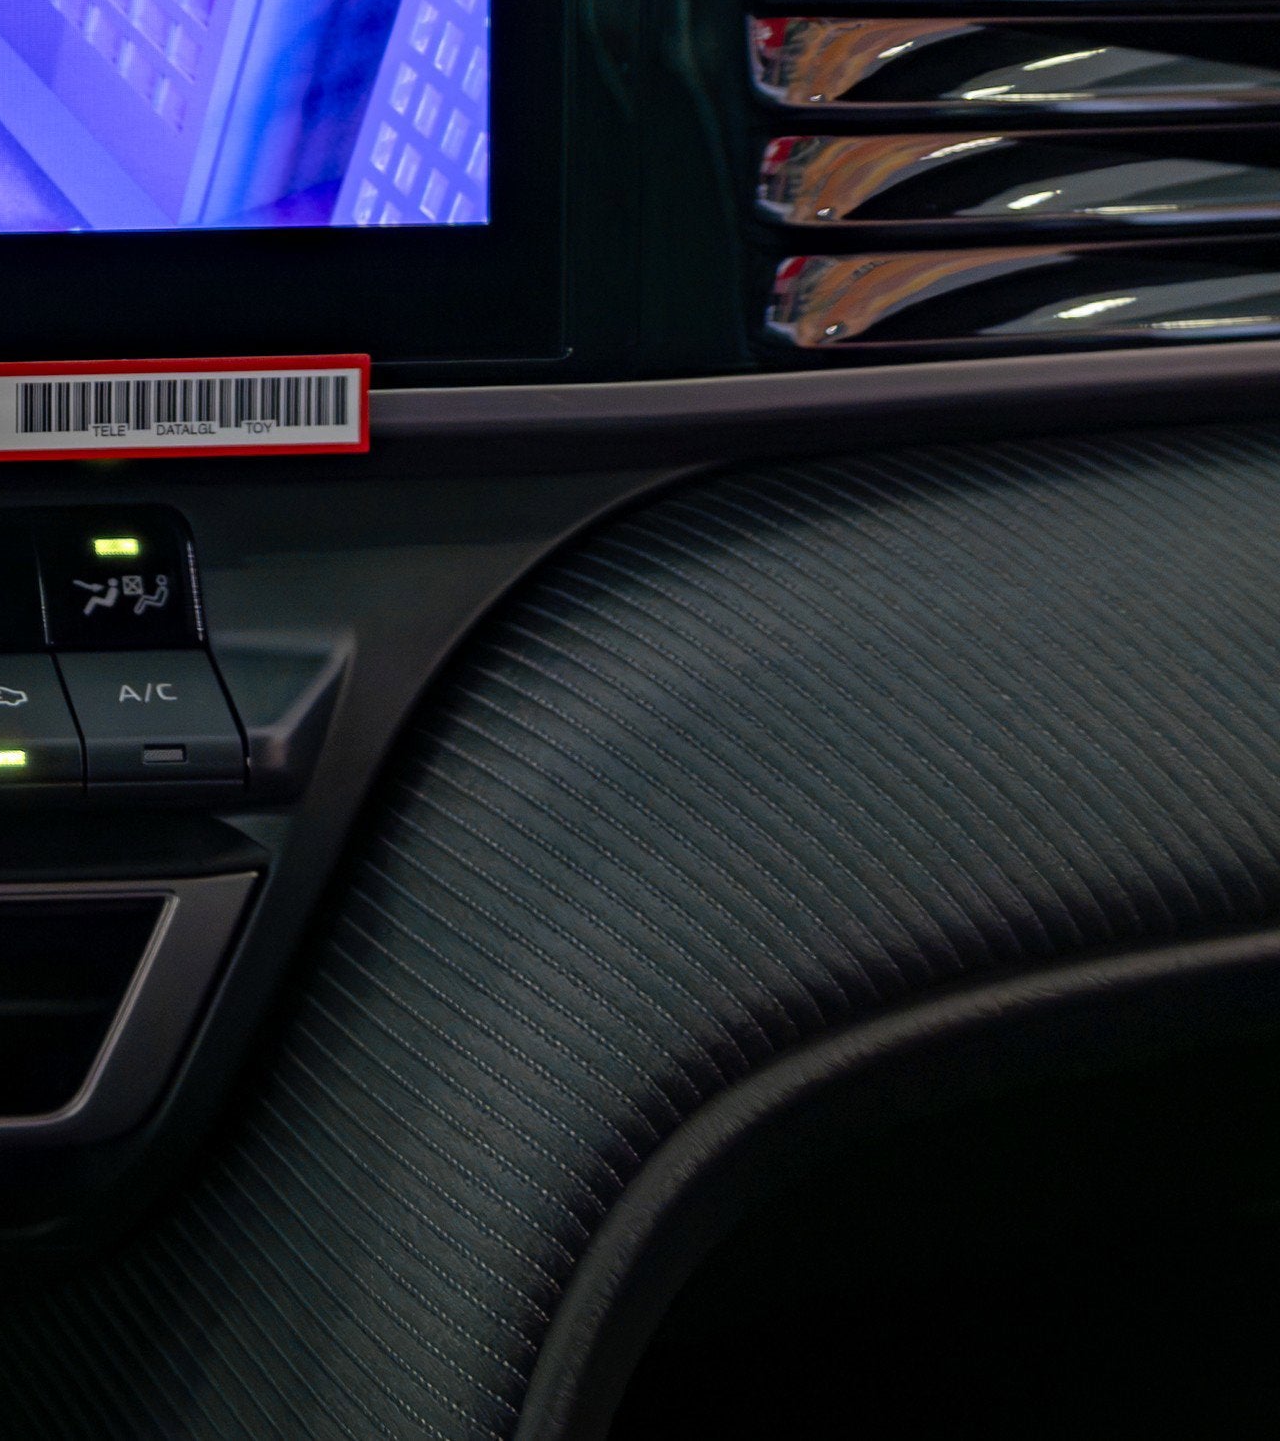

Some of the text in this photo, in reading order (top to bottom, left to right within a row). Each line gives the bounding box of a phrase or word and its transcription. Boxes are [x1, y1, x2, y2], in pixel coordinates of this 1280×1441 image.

[92, 425, 126, 437] TELE
[245, 421, 273, 434] TOY
[118, 682, 178, 704] A/C
